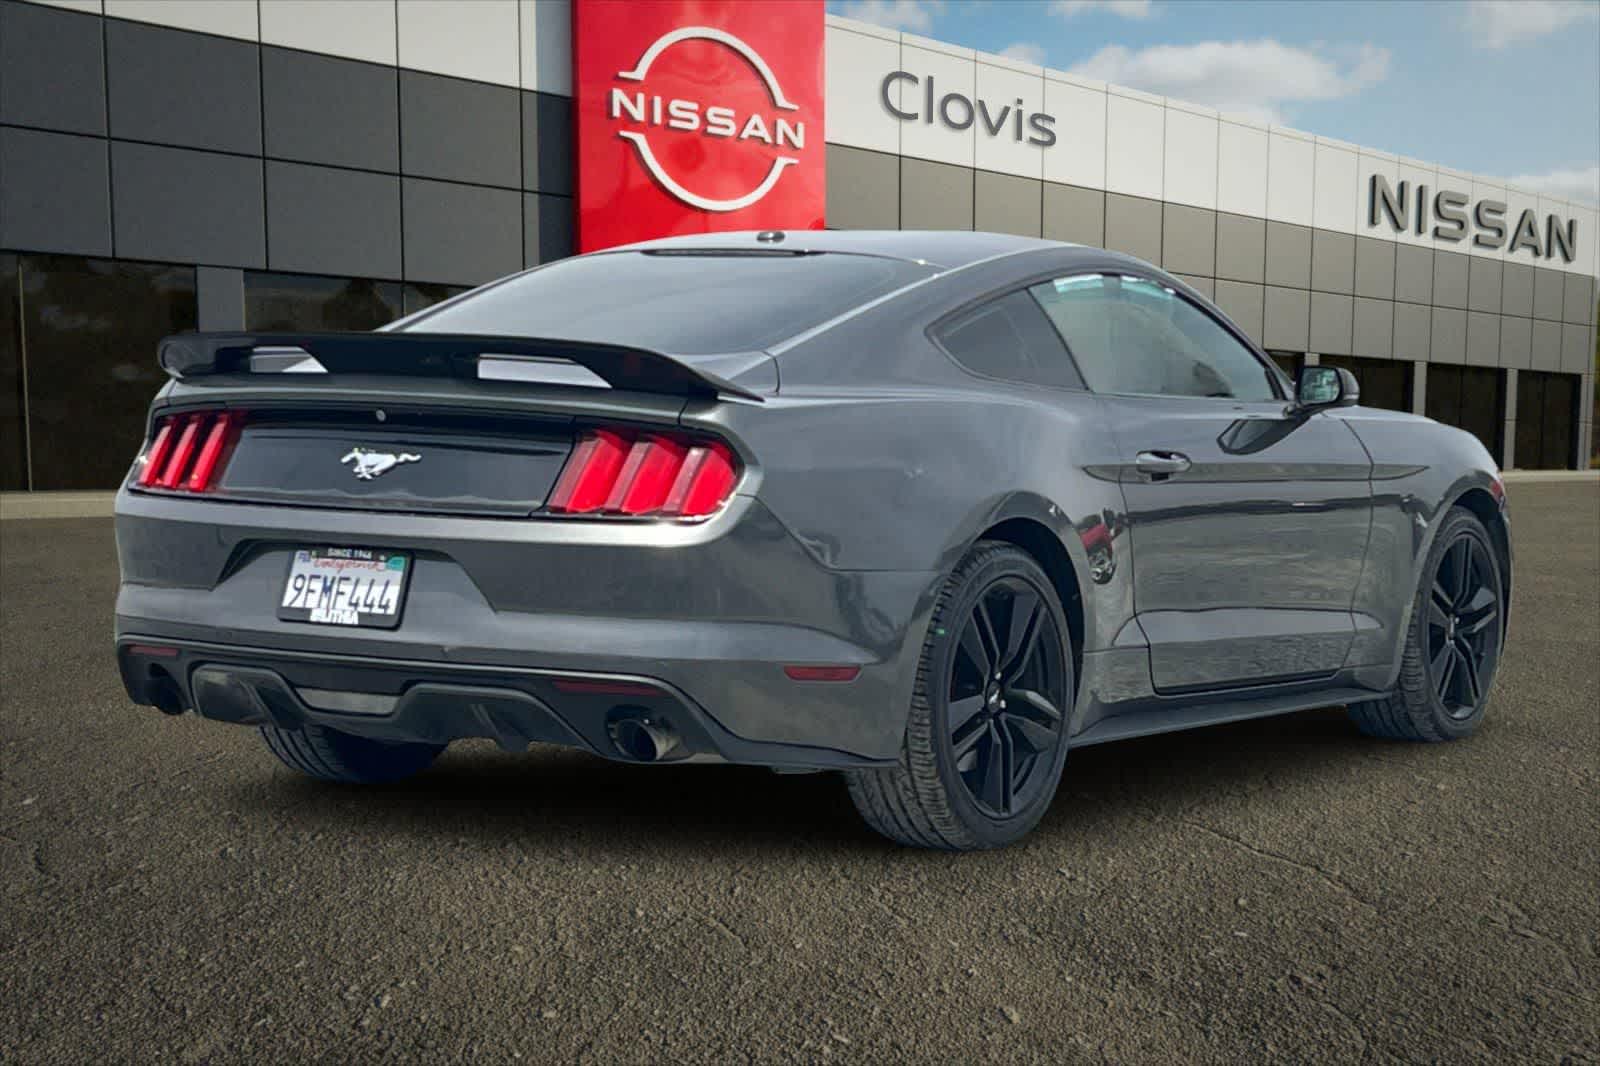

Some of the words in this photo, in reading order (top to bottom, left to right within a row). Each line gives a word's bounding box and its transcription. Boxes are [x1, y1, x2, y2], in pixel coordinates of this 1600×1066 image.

[611, 87, 805, 149] NISSAN
[881, 70, 1057, 147] Clovis
[1368, 173, 1577, 263] NISSAN
[289, 573, 391, 614] 9FMF444
